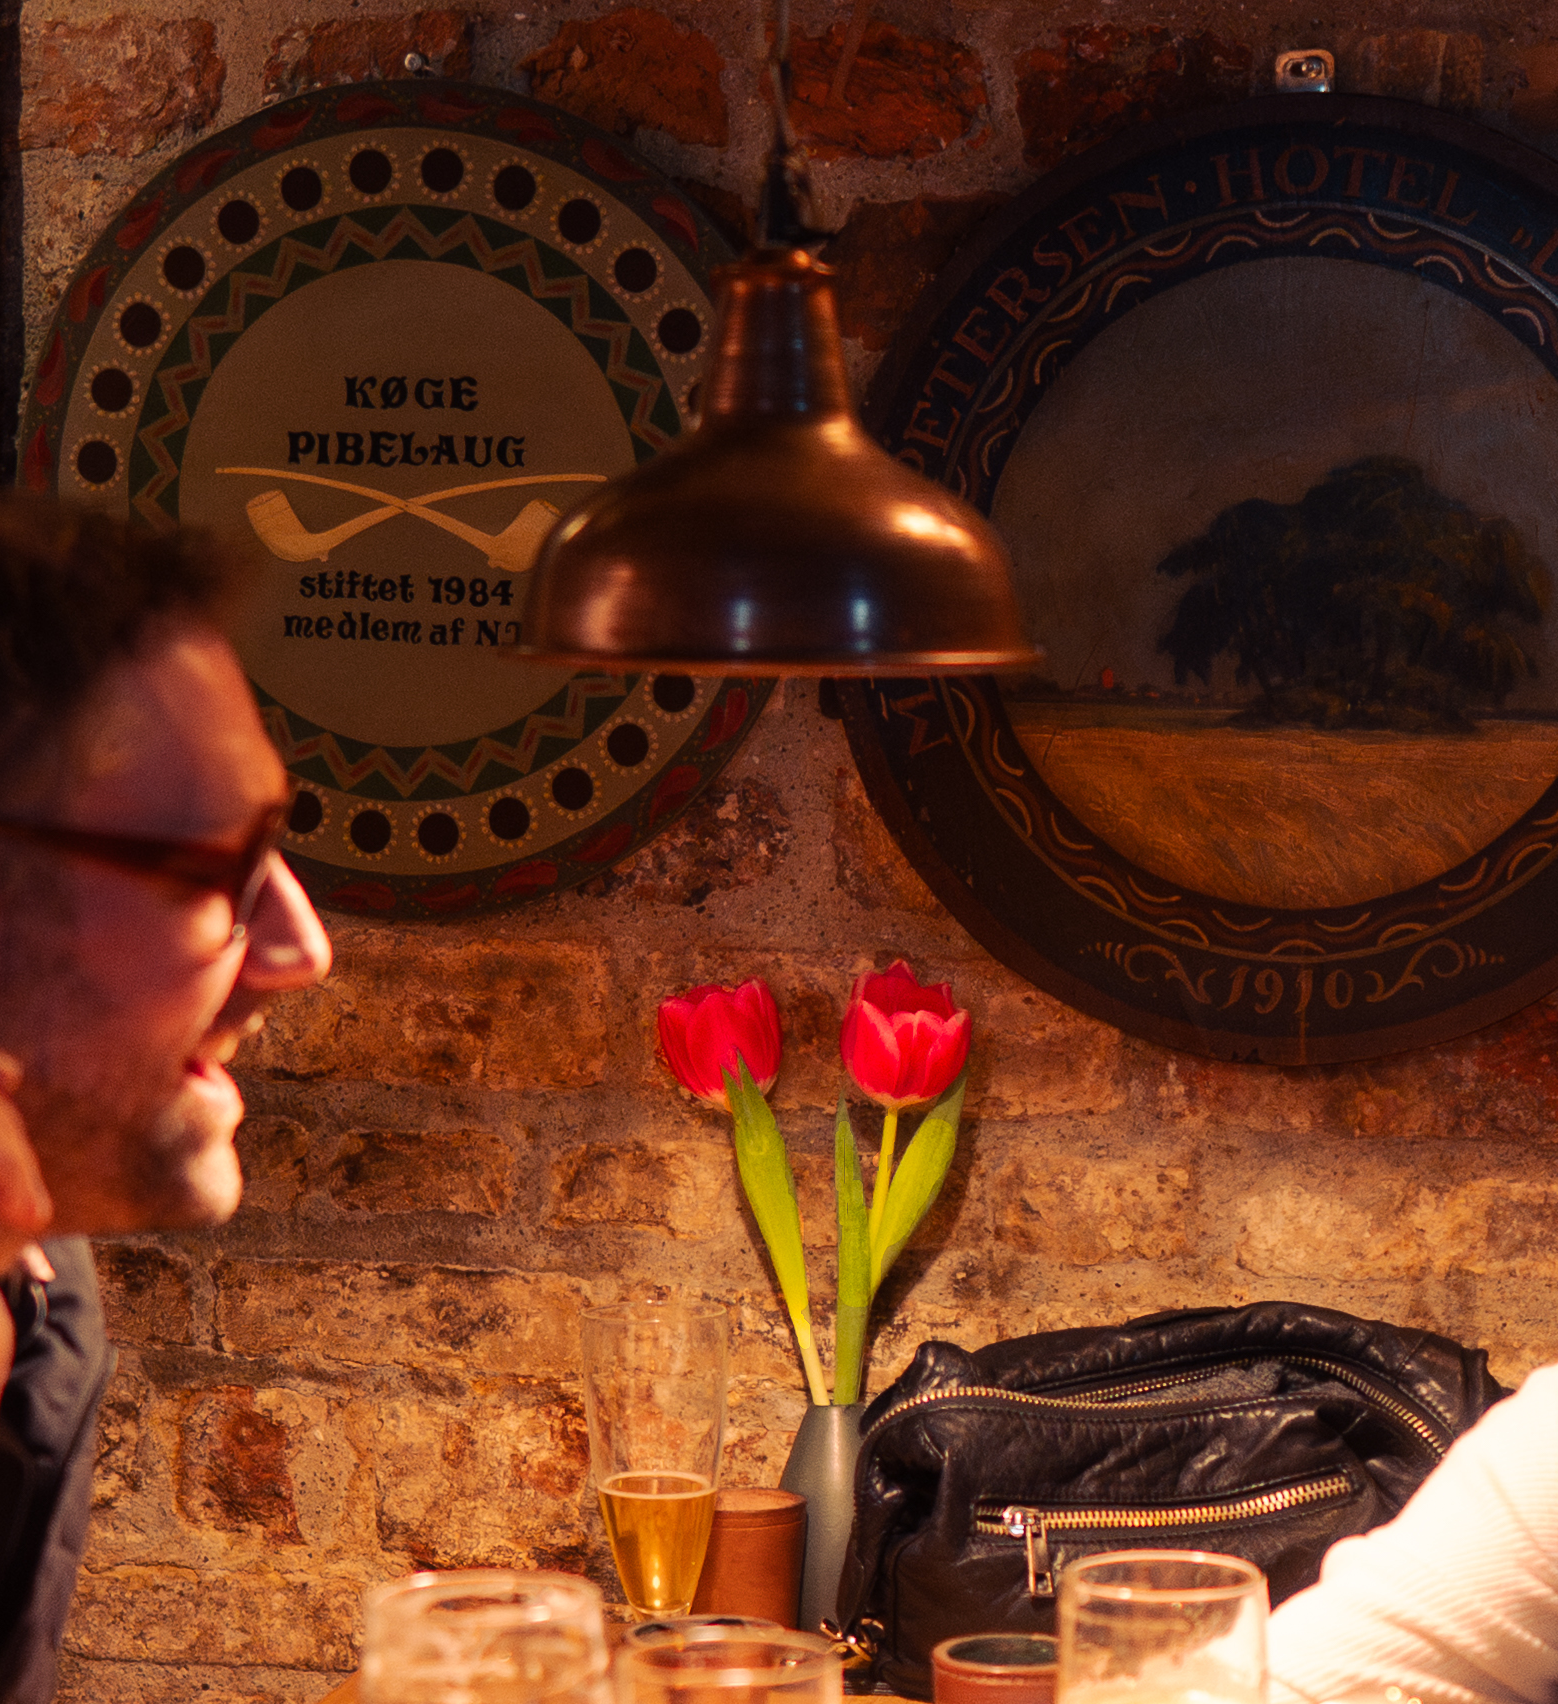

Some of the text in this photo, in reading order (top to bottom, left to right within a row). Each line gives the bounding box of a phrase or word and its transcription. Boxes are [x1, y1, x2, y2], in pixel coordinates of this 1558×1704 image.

[1209, 142, 1480, 227] HOTEL
[343, 375, 479, 411] KØGE
[287, 430, 526, 468] PIBELAUG
[299, 570, 514, 607] stiftet 1984
[283, 611, 423, 645] medlem
[429, 617, 465, 646] af
[1217, 965, 1354, 1014] 1910
